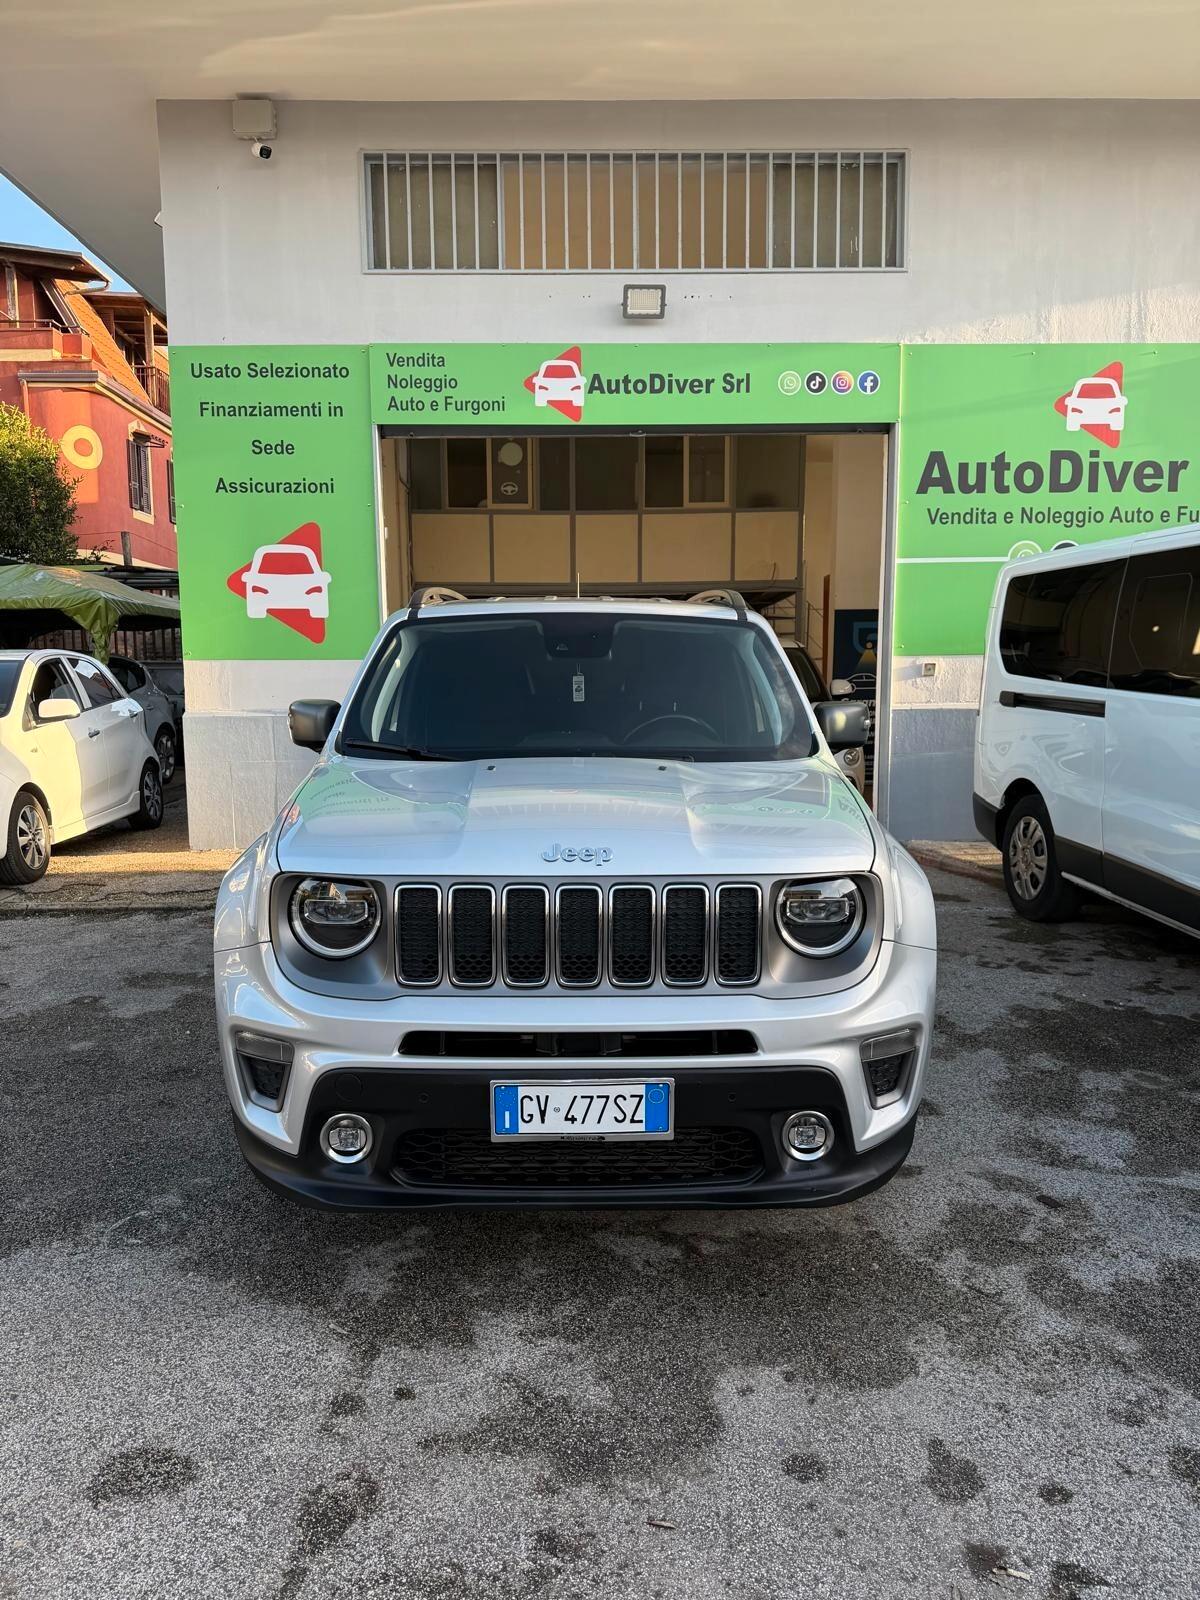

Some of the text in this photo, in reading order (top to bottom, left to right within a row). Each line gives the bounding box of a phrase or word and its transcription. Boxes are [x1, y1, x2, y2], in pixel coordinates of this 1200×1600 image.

[385, 352, 446, 368] Vendita
[190, 362, 350, 379] Usato Selezionato
[387, 374, 458, 392] Noleggio
[587, 372, 751, 395] AutoDiver Srl
[199, 401, 344, 418] Finanziamenti in
[387, 395, 505, 416] Auto e Furgoni
[251, 439, 295, 455] Sede
[915, 449, 1190, 495] AutoDiver
[215, 477, 334, 494] Assicurazioni
[926, 507, 997, 525] Vendita
[1003, 511, 1014, 525] e
[1020, 506, 1105, 529] Noleggio
[1109, 506, 1154, 524] Auto
[1159, 510, 1171, 524] e
[541, 843, 614, 866] Jeep
[520, 1094, 550, 1125] GV
[564, 1094, 644, 1125] 477SZ
